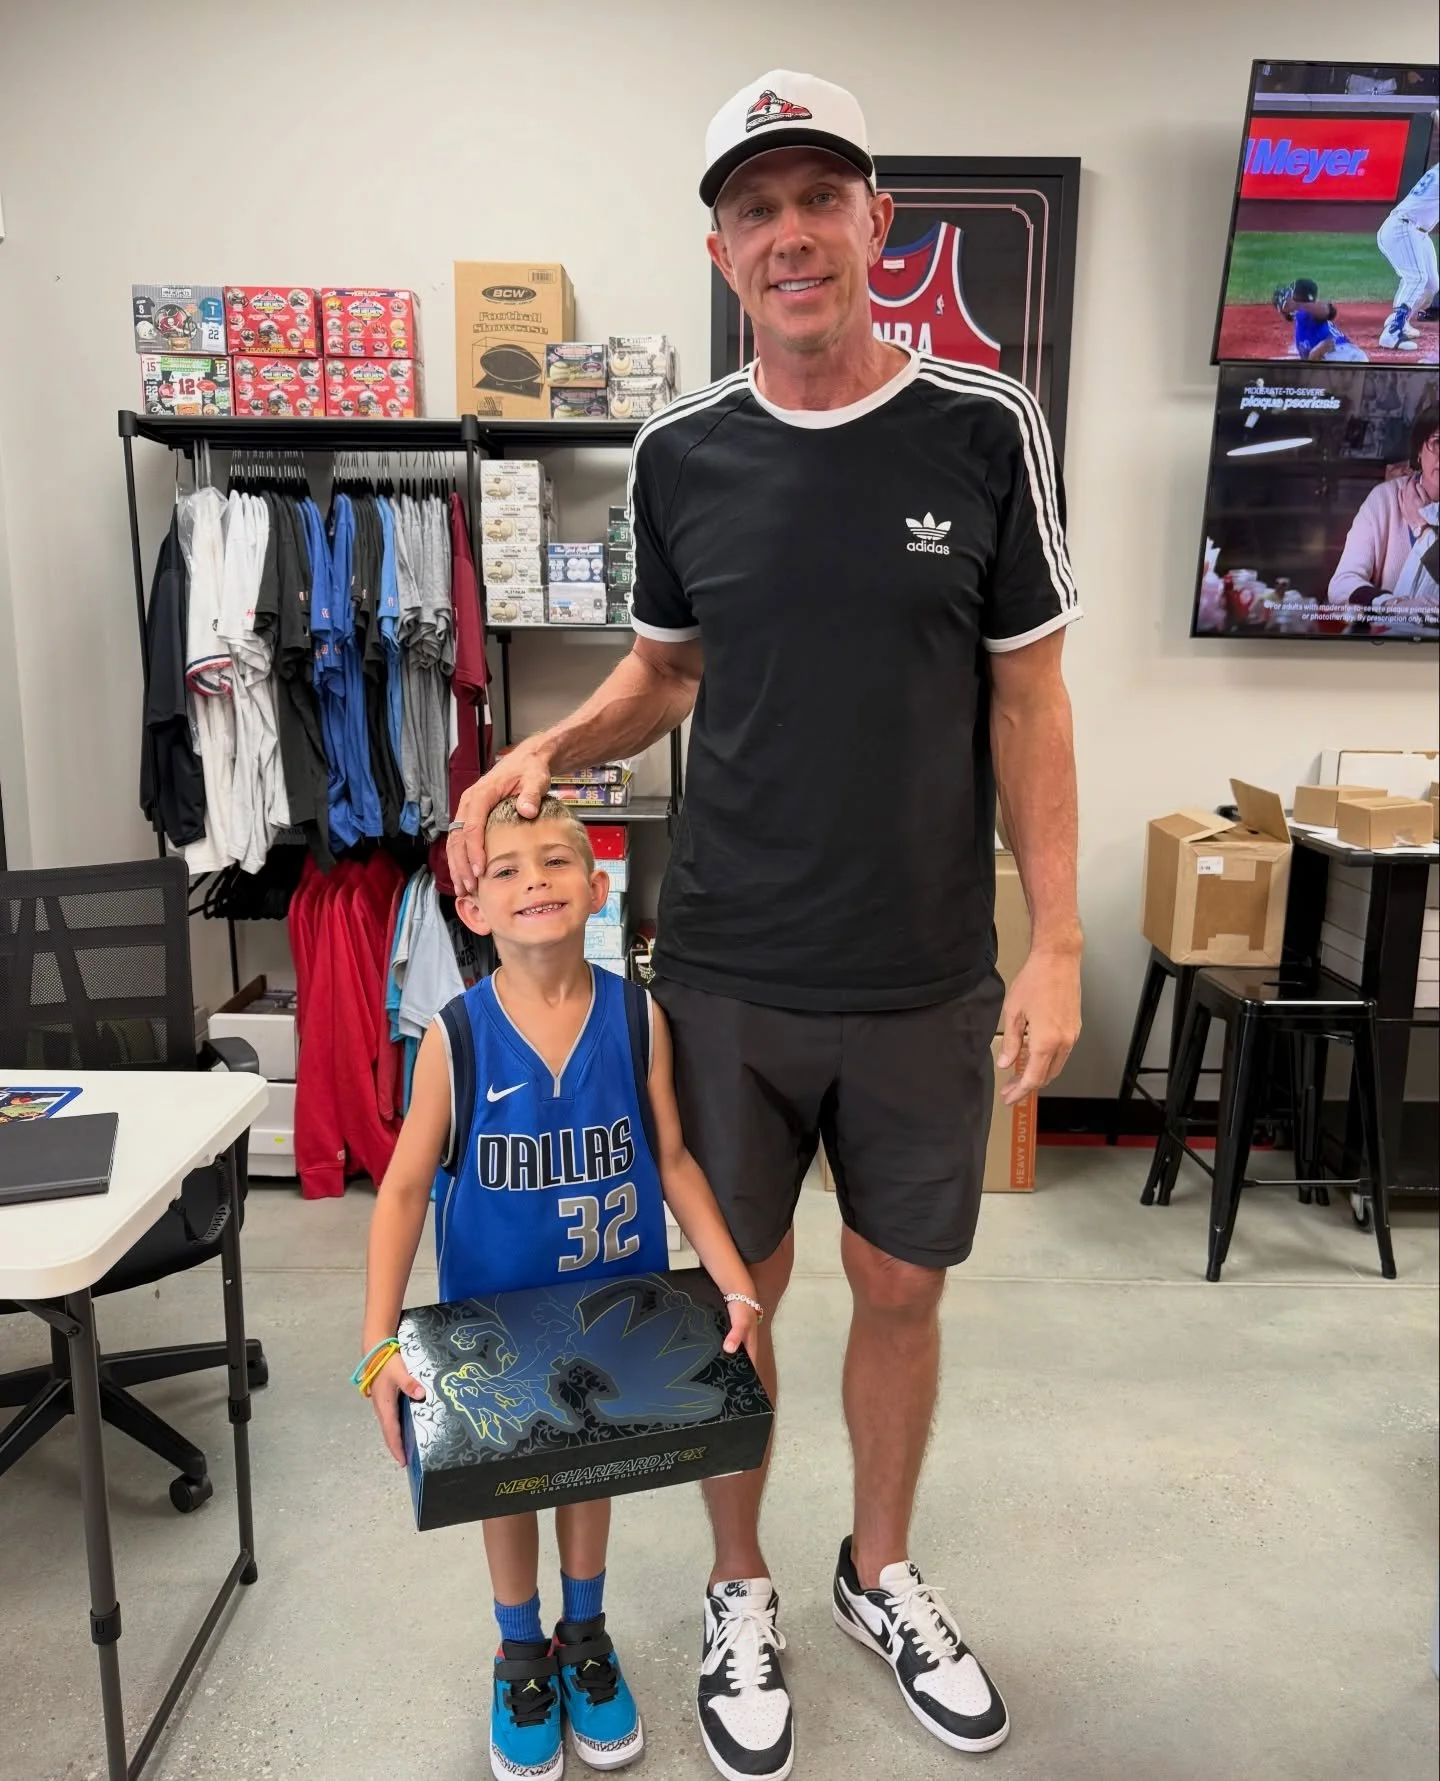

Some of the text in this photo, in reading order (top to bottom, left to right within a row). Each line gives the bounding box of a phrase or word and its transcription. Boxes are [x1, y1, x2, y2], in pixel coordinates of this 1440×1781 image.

[493, 289, 525, 298] BCW
[138, 304, 145, 315] 8
[479, 311, 542, 323] Football
[208, 329, 219, 340] 22
[473, 323, 549, 335] Showcase
[146, 361, 156, 372] 15
[215, 363, 227, 374] 12
[146, 385, 158, 396] 22
[178, 378, 195, 395] 12
[1240, 395, 1341, 411] plaque psoriasis
[906, 540, 950, 555] adidas
[1282, 602, 1303, 611] adults
[1304, 603, 1319, 611] with
[1367, 615, 1407, 624] prescription
[604, 769, 617, 783] 15
[586, 790, 599, 800] 35
[610, 791, 623, 804] 15
[478, 1116, 635, 1191] DALLAS
[1016, 1147, 1025, 1184] HEAVY
[558, 1182, 640, 1272] 32
[495, 1446, 708, 1496] MEGA CHARIZARD X ex
[530, 1465, 672, 1495] ULTRA-PREMIUM COLLECTION
